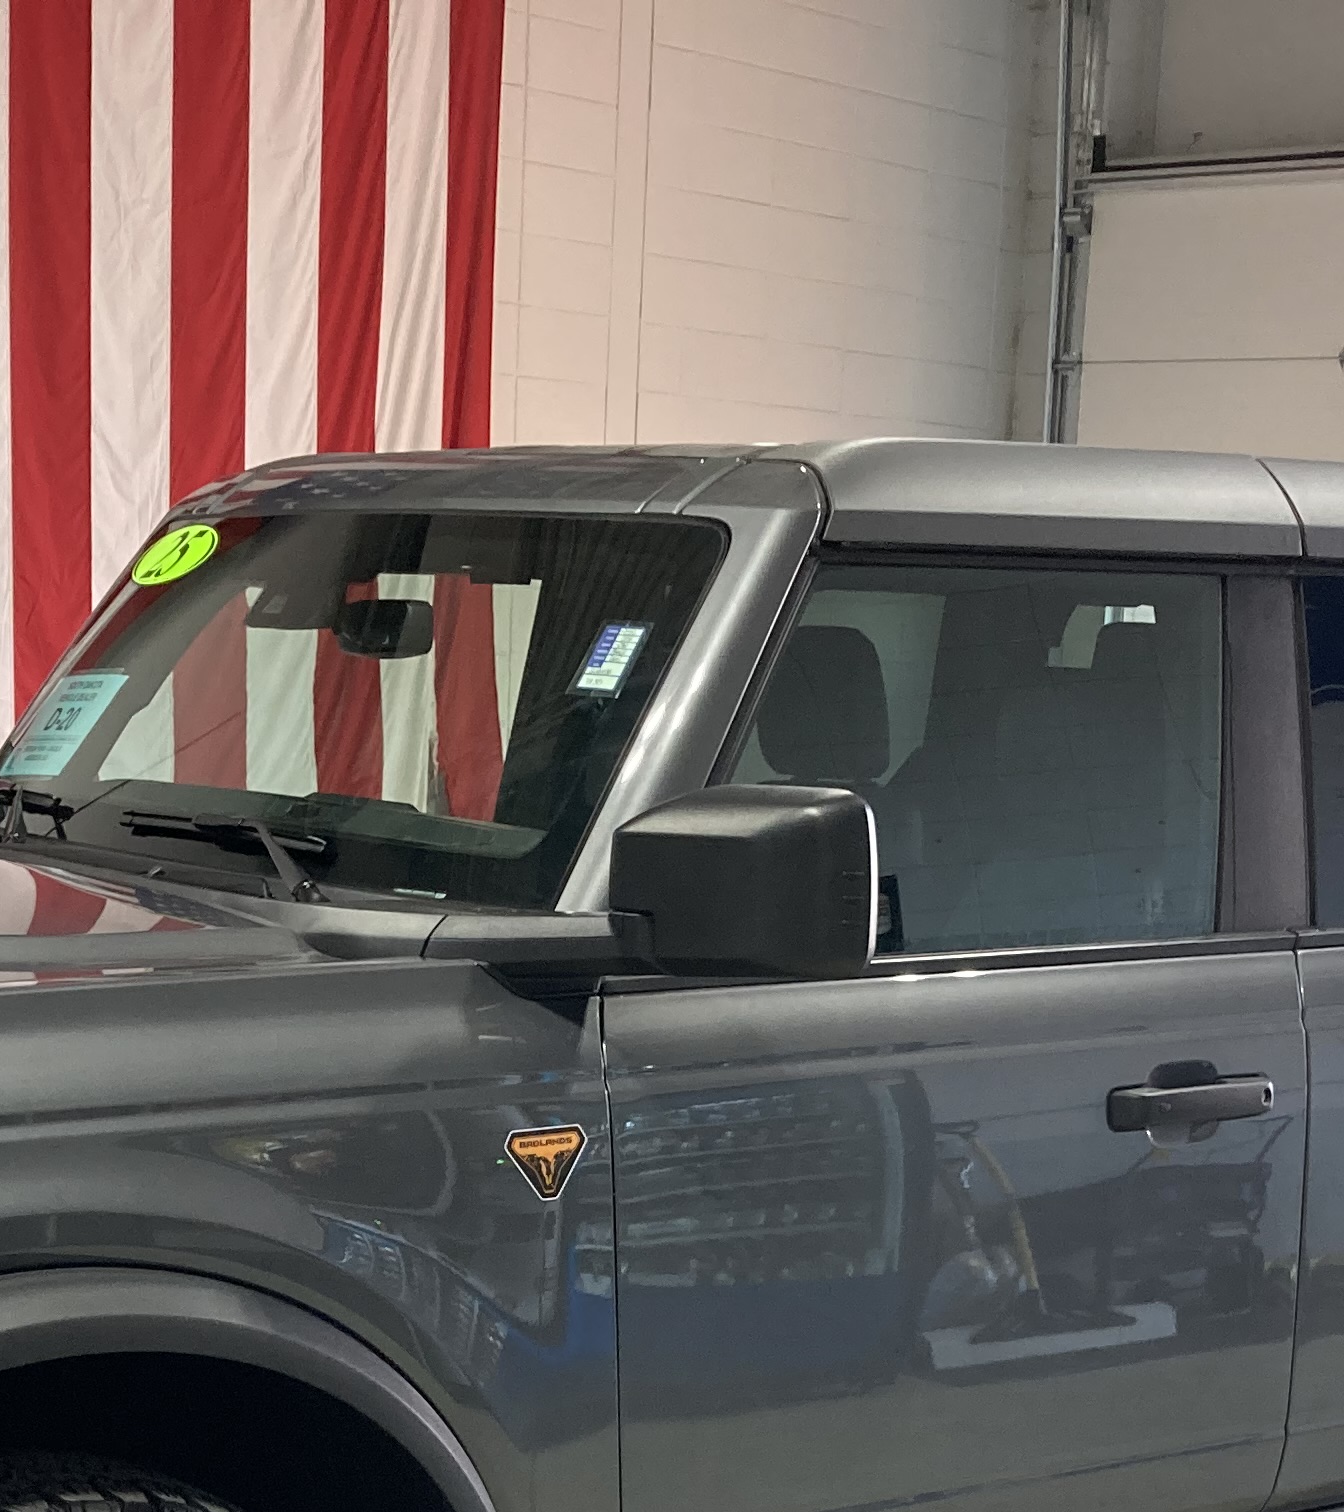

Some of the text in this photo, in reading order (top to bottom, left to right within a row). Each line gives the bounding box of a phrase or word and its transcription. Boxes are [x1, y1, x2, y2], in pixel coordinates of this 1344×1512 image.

[139, 529, 210, 579] 25
[43, 707, 82, 730] D-20
[519, 1137, 573, 1148] BADLANDS
